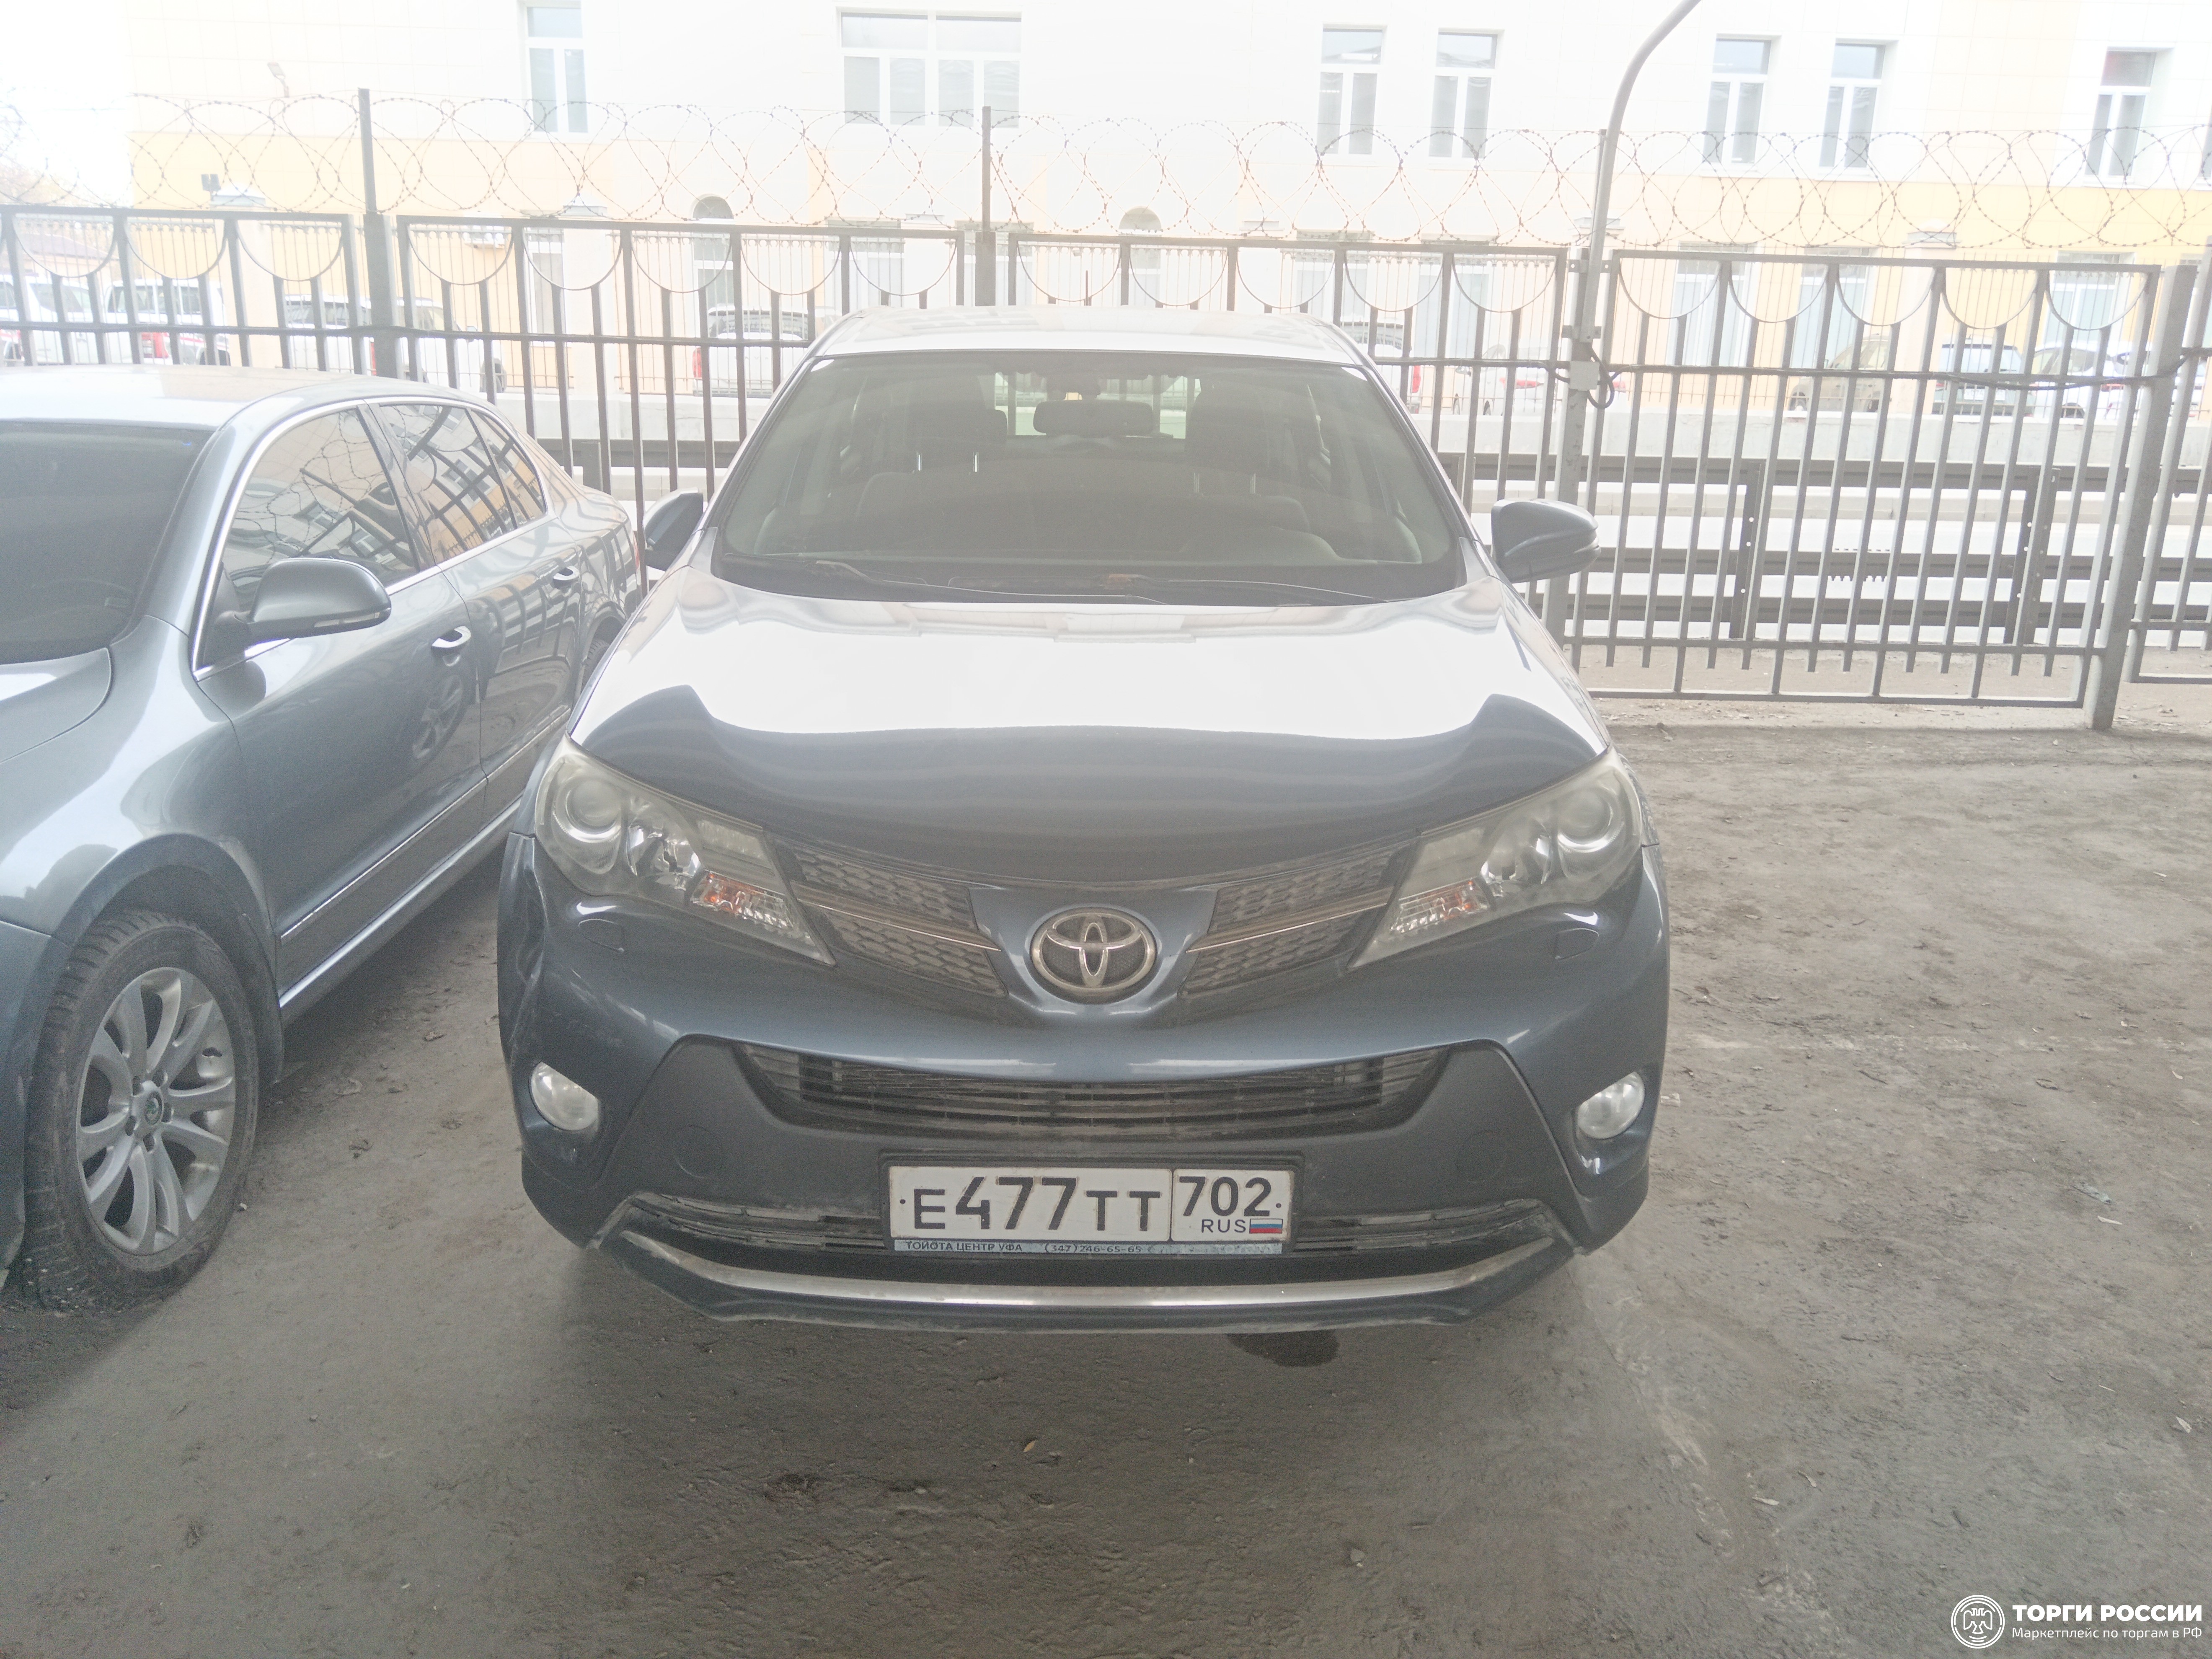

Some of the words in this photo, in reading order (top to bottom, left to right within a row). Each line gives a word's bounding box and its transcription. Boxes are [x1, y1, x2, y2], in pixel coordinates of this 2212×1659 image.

[1179, 1176, 1271, 1217] 702
[1201, 1219, 1246, 1233] RUS
[956, 1242, 995, 1252] ЦЕНТР
[999, 1243, 1023, 1251] УФА
